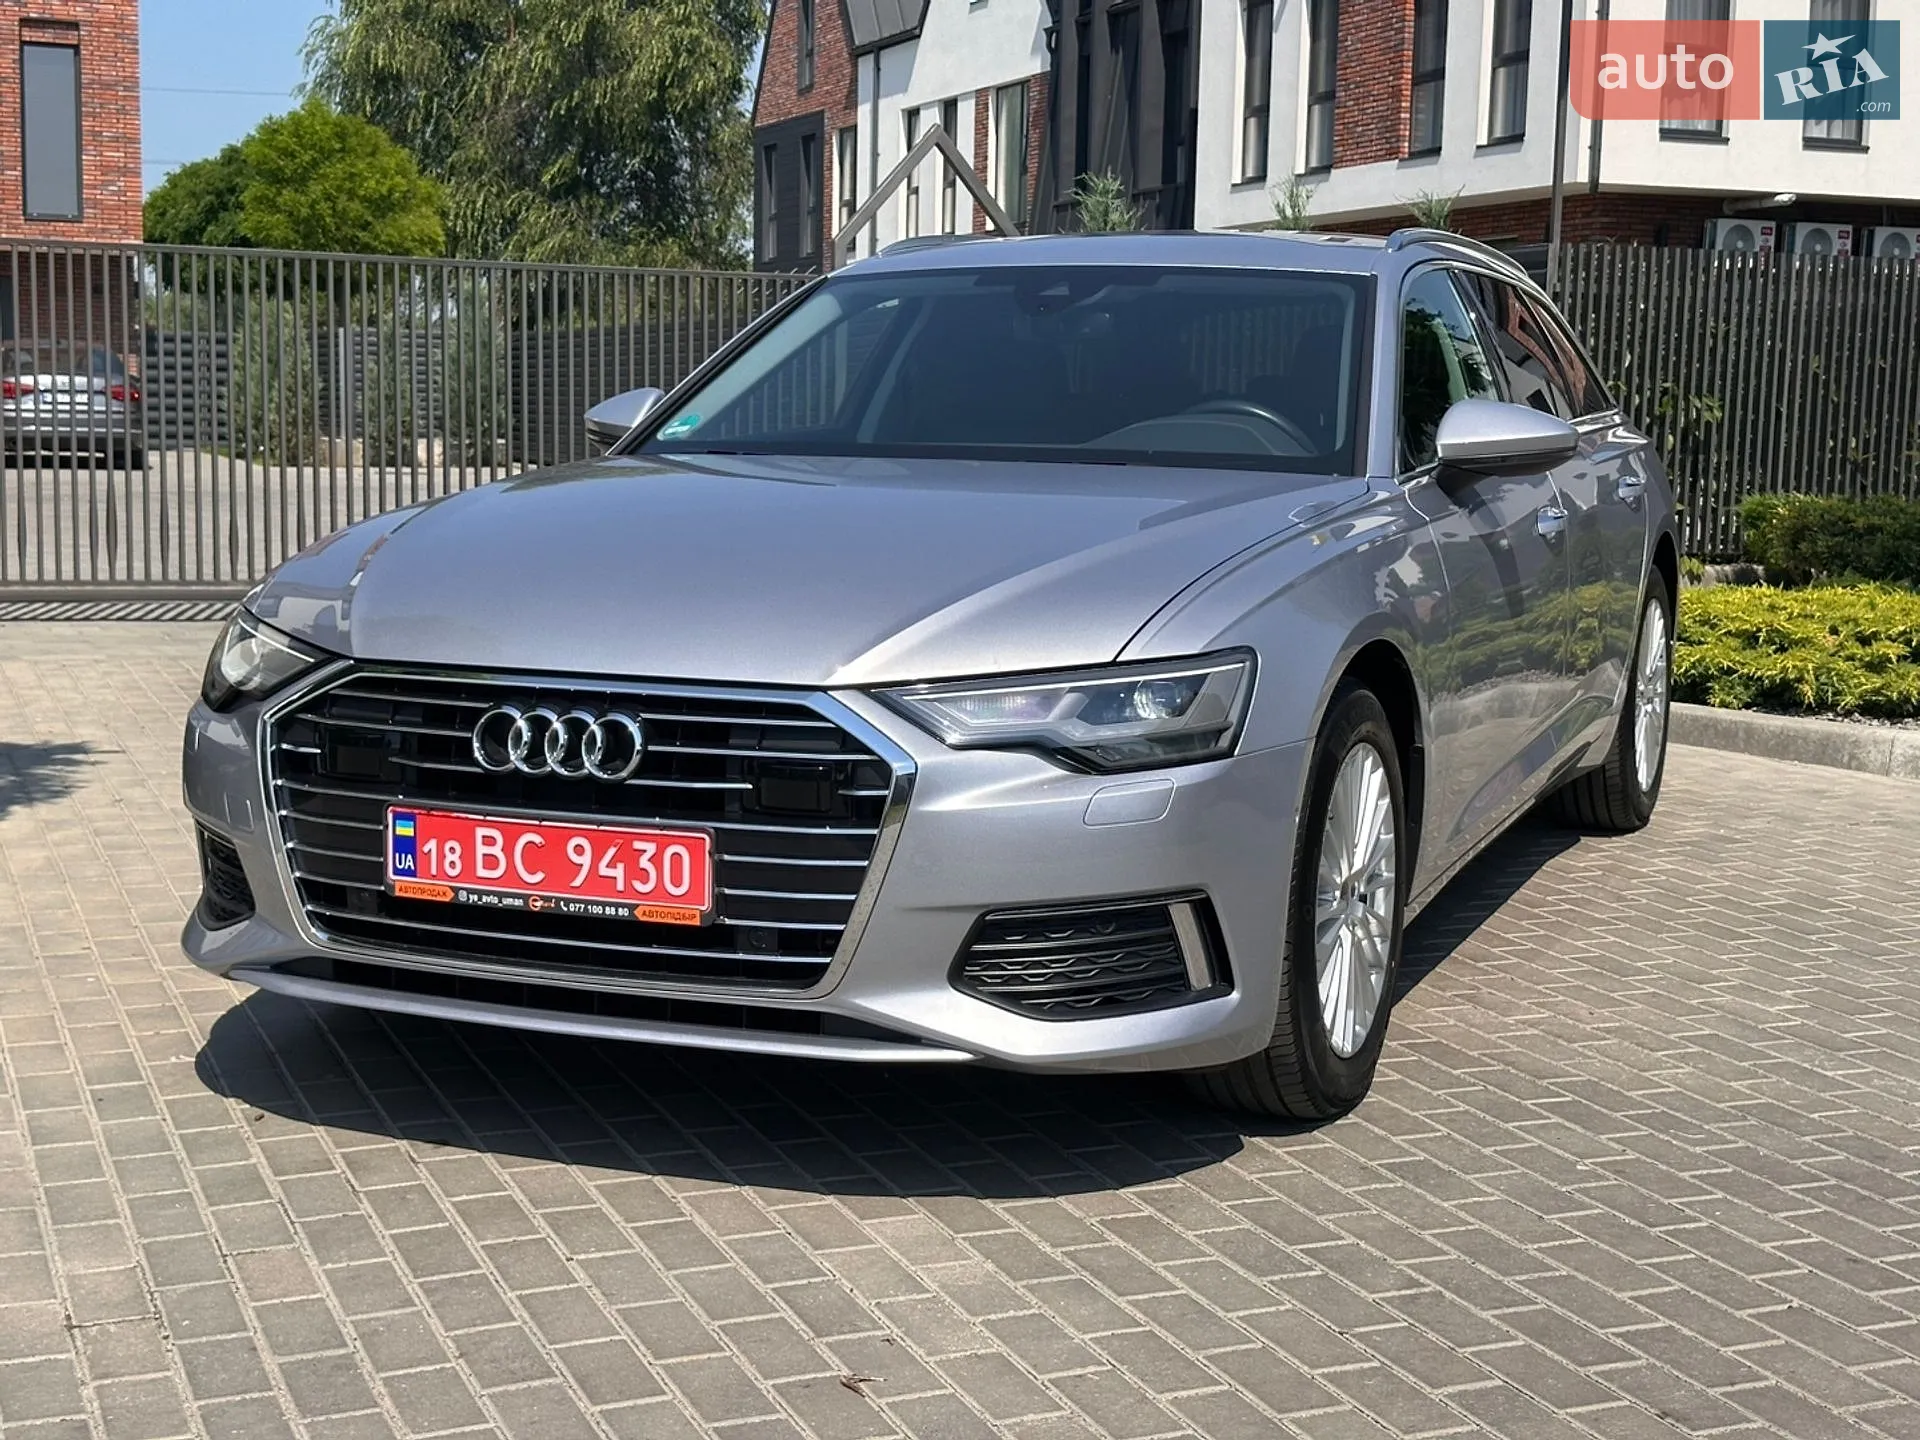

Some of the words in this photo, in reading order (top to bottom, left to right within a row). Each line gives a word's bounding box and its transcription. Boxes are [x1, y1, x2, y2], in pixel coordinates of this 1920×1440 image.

[395, 853, 415, 871] UA
[421, 838, 463, 878] 18
[474, 826, 546, 884] BC
[566, 835, 691, 897] 9430
[569, 903, 585, 912] 077
[587, 905, 603, 914] 100
[641, 909, 698, 922] АВТОПІДБІР
